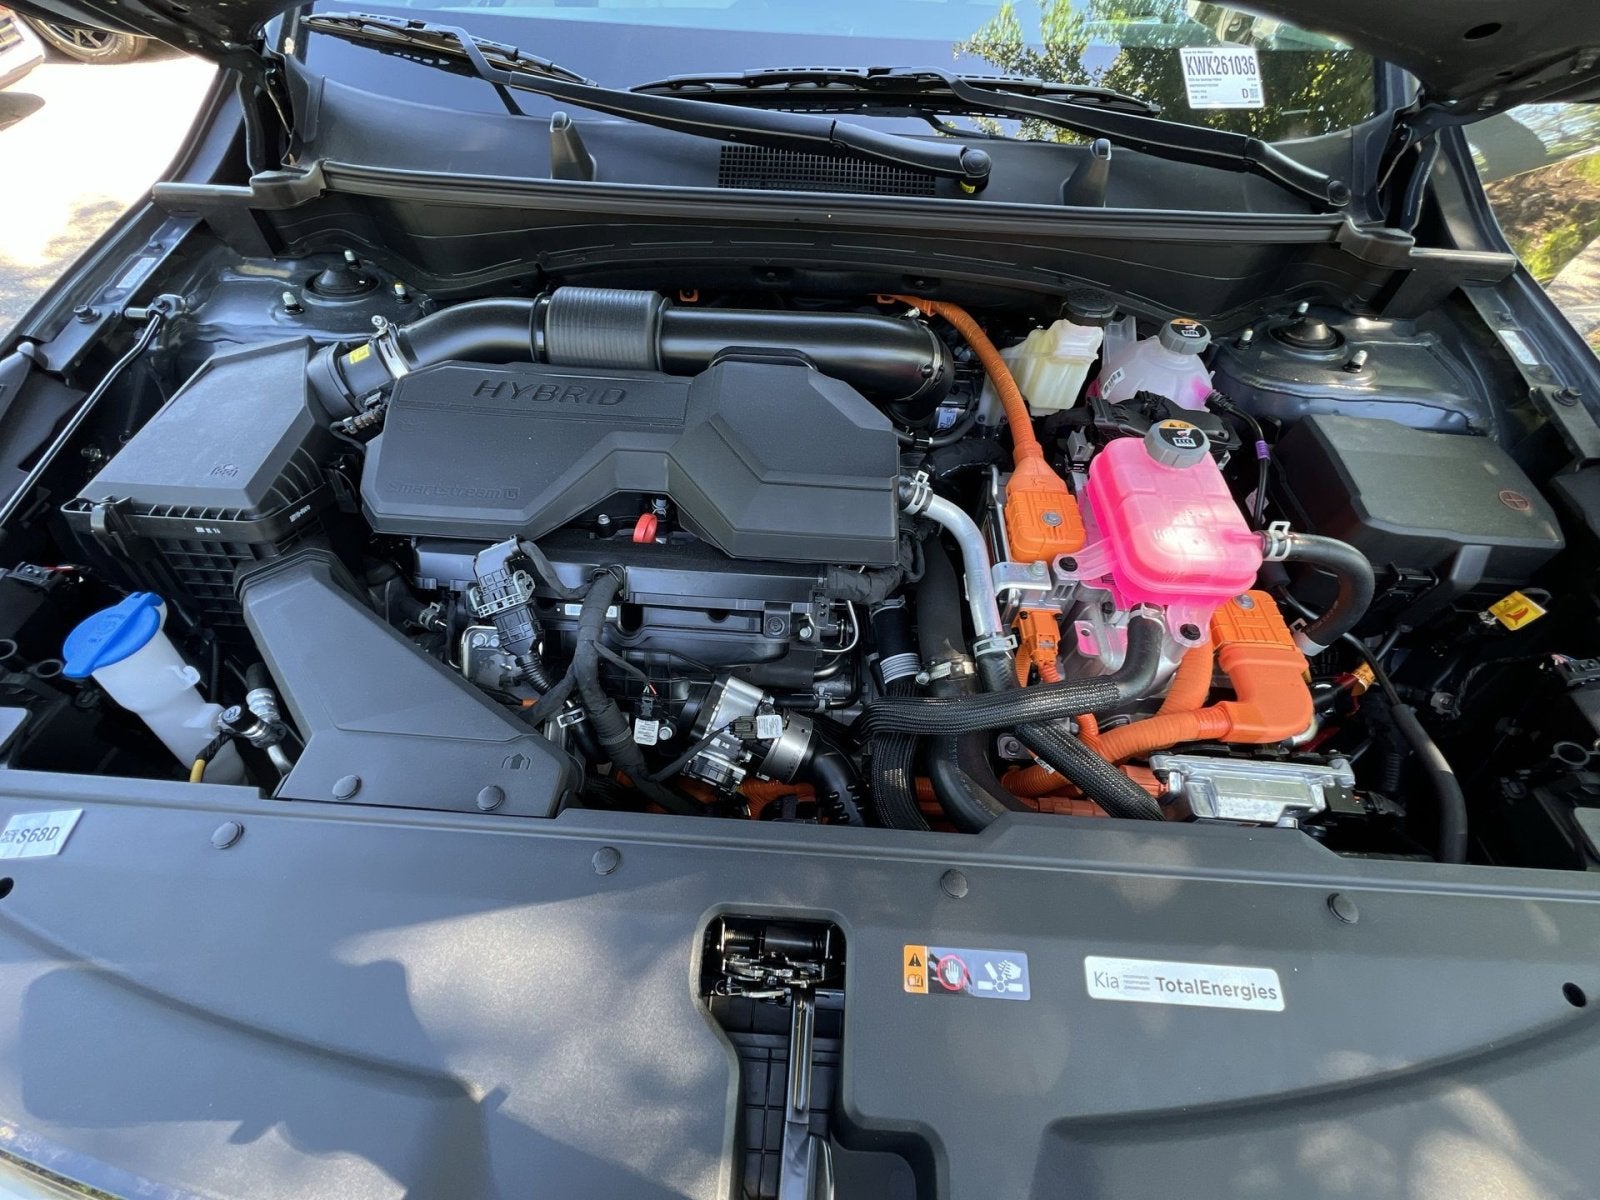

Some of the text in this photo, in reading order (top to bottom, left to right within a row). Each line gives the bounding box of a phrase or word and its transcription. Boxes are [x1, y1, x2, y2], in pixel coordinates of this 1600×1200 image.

[1185, 55, 1256, 76] KWK261036
[1241, 88, 1249, 99] D
[472, 379, 628, 406] HYBRID
[16, 826, 60, 844] S68D
[1093, 971, 1278, 1002] Kia TotalEnergies
